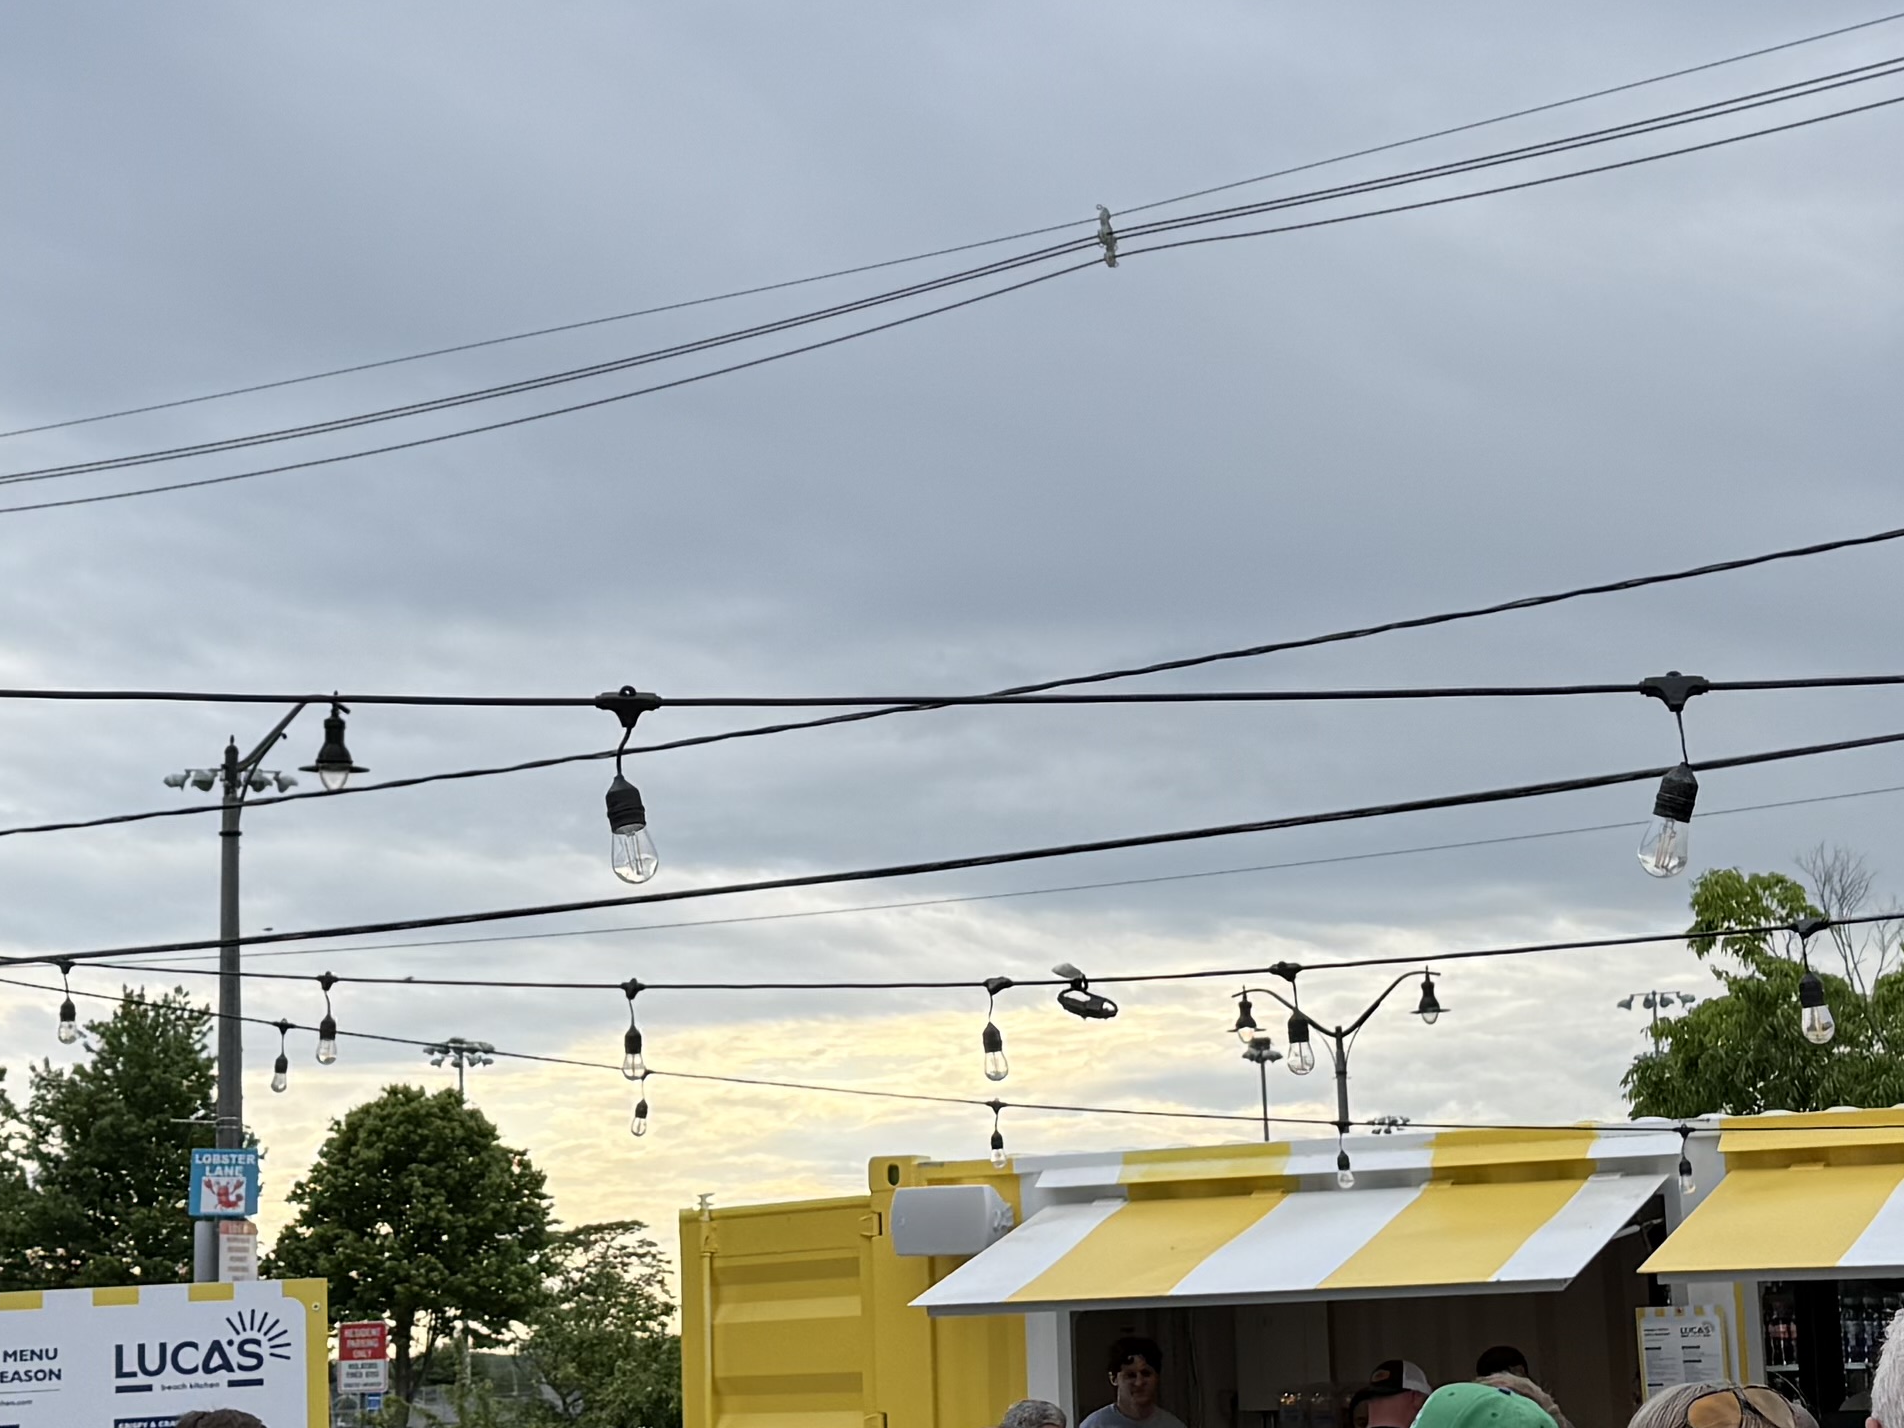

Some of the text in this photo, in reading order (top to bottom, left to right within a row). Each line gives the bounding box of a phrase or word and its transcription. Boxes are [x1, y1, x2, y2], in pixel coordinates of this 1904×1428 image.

[195, 1153, 255, 1164] LOBSTER
[205, 1165, 244, 1176] LANE
[2, 1347, 58, 1363] MENU
[161, 1380, 220, 1391] beach kitchen
